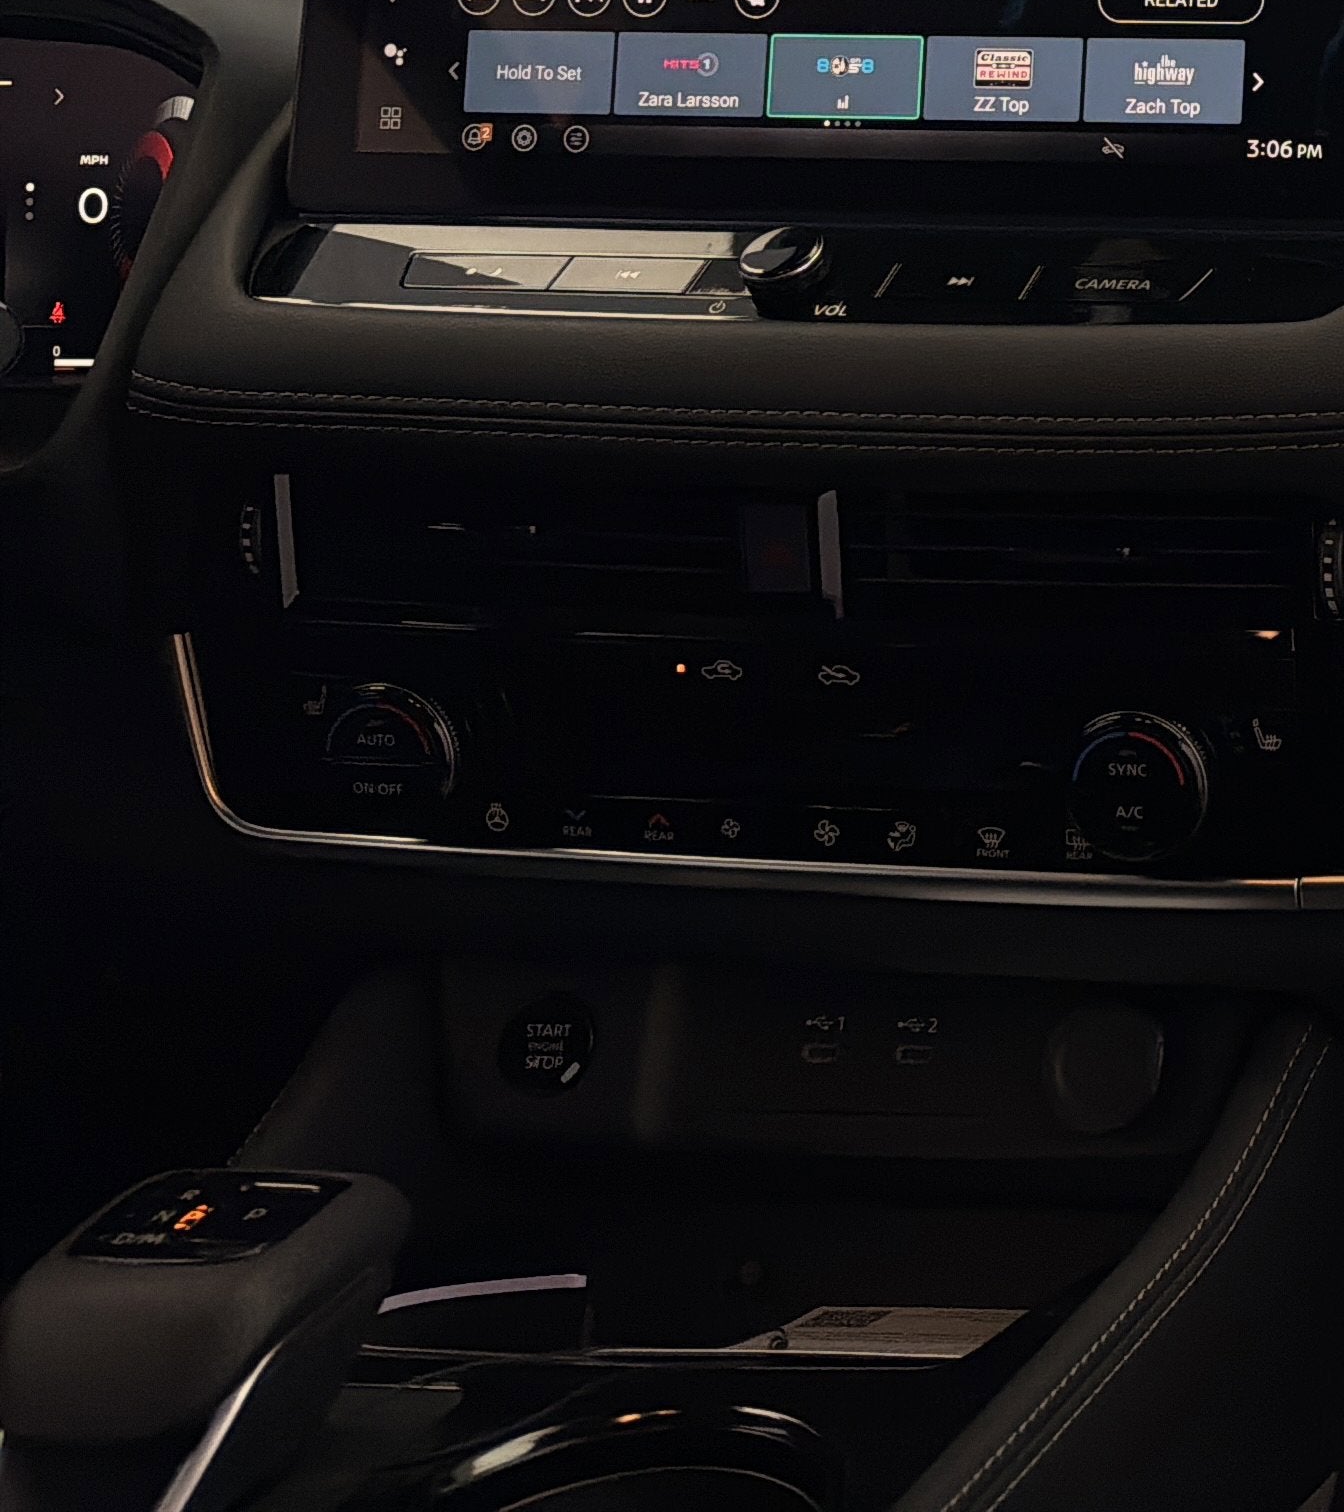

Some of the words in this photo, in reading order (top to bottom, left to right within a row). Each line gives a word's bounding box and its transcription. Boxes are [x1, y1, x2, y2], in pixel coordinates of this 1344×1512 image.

[979, 51, 1029, 64] Classic
[1161, 54, 1177, 69] the
[496, 64, 532, 81] Hold
[535, 65, 556, 81] To
[559, 65, 582, 81] Set
[979, 69, 1029, 80] REWIND
[1134, 61, 1195, 86] highway
[638, 92, 674, 108] Zara
[677, 92, 739, 109] Larsson
[973, 97, 998, 113] ZZ
[1000, 97, 1030, 117] Top
[1125, 98, 1163, 115] Zach
[1165, 99, 1201, 119] Top
[481, 127, 491, 140] 2
[1246, 139, 1293, 159] 3:06
[1297, 144, 1323, 159] PM
[79, 154, 109, 166] MPH
[78, 187, 109, 225] 0
[1075, 278, 1151, 291] CAMERA
[814, 303, 848, 318] VOL
[52, 345, 61, 357] 0
[356, 733, 397, 748] AUTO
[1108, 762, 1148, 777] SYNC
[1115, 805, 1145, 820] A/C
[526, 1023, 573, 1038] START
[524, 1055, 564, 1070] STOP
